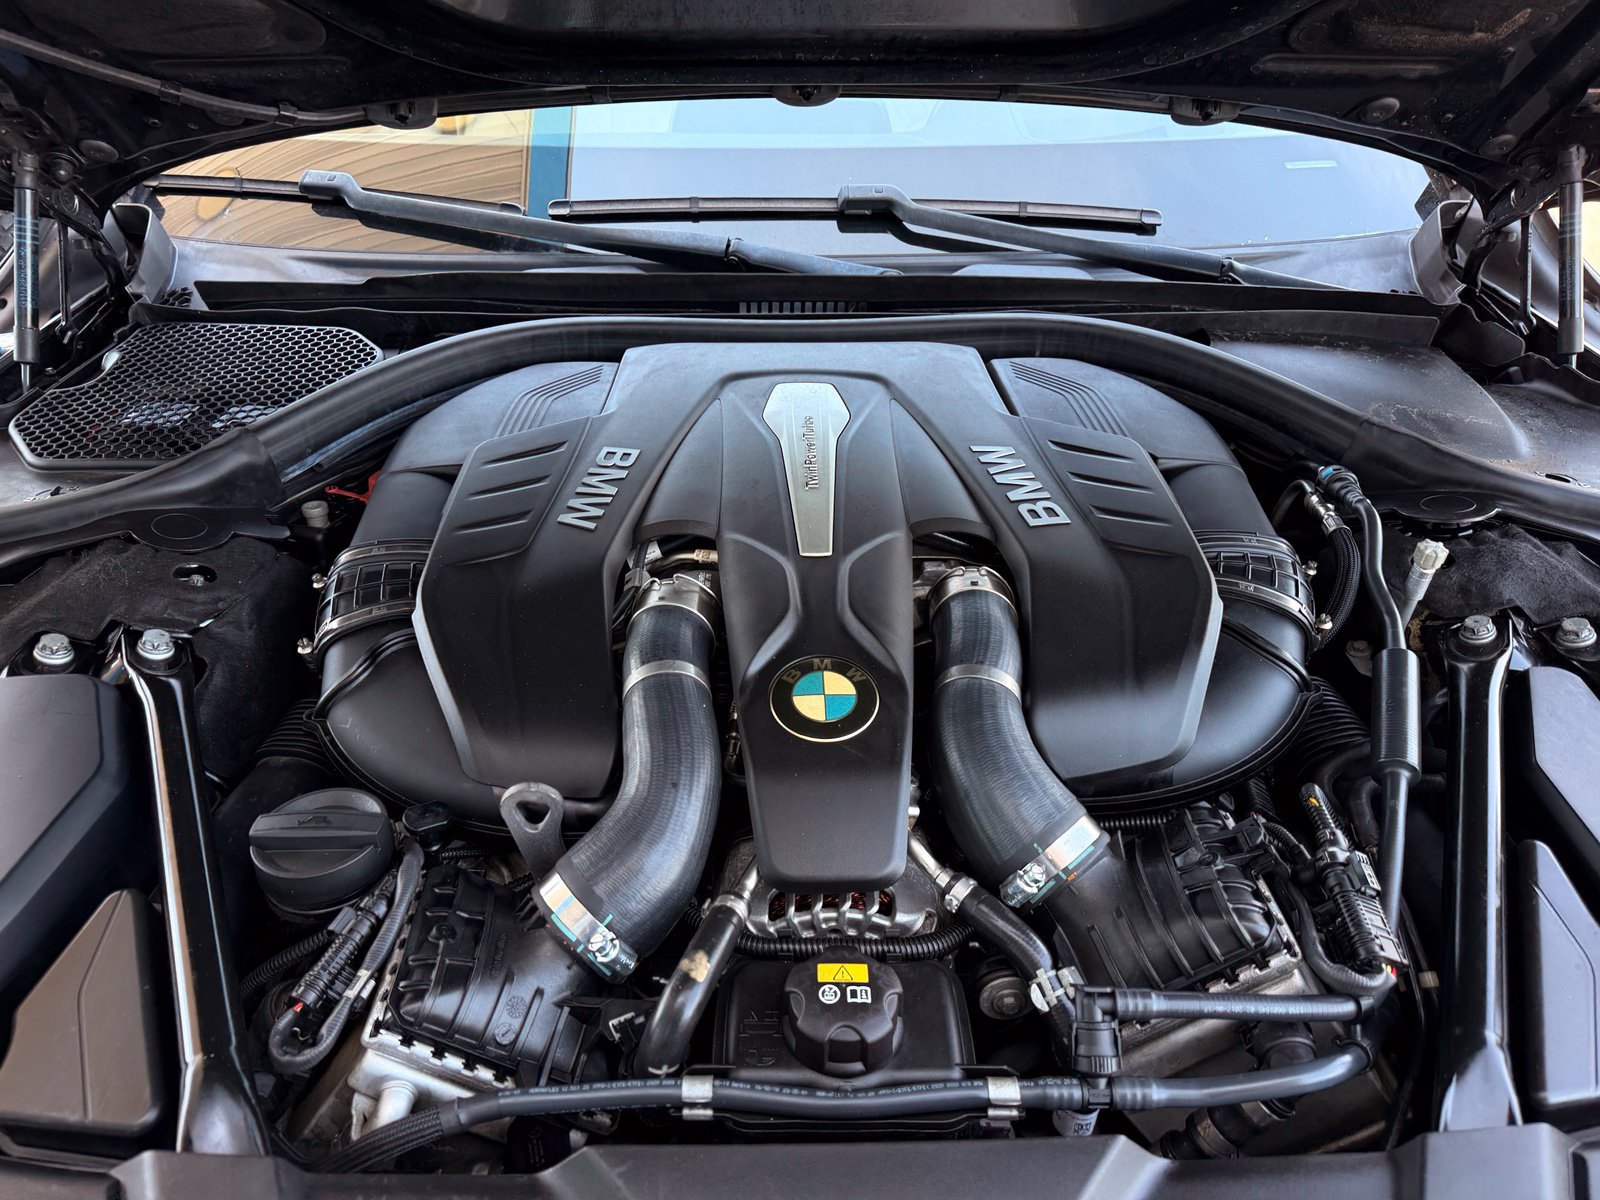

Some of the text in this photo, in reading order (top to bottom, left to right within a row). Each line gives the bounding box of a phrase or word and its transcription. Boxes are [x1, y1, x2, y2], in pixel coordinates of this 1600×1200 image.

[556, 446, 641, 532] BMW
[969, 445, 1072, 528] BMW
[780, 657, 867, 684] BMW
